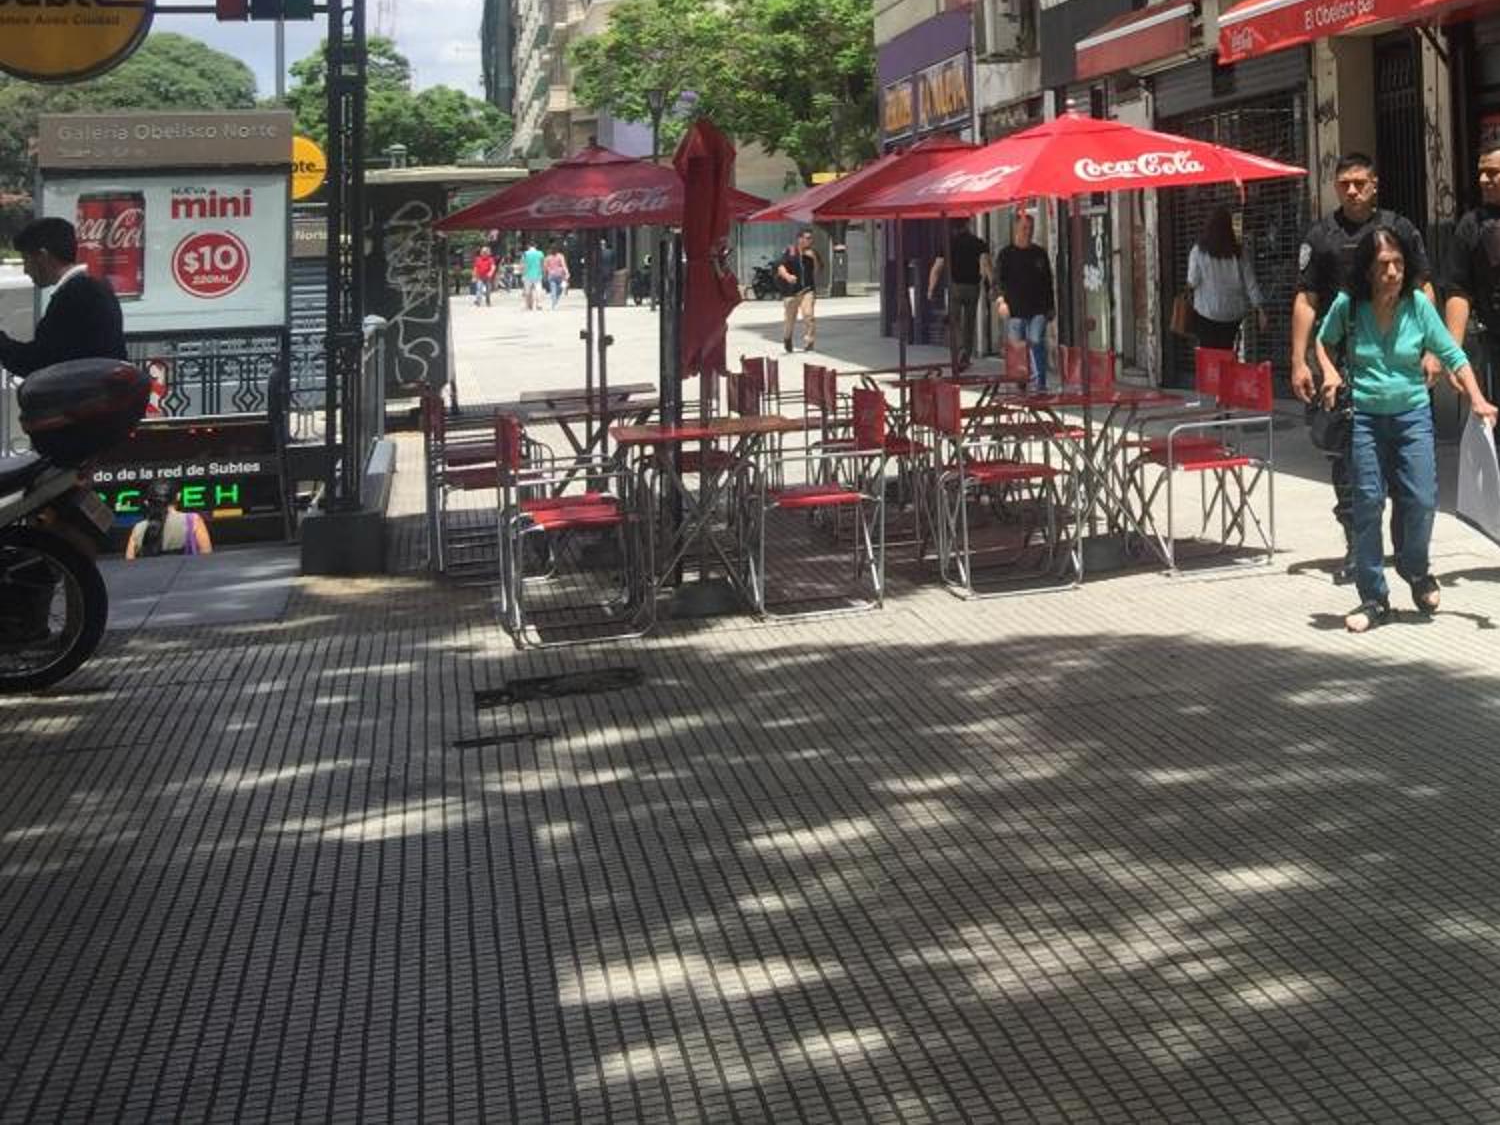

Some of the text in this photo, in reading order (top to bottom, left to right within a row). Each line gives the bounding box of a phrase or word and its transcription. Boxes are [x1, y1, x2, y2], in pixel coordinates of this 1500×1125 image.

[1305, 10, 1315, 30] El
[1315, 0, 1355, 26] Obelisco
[1073, 150, 1205, 182] Coca-Cola
[171, 189, 252, 219] mini
[183, 245, 239, 273] $10
[117, 468, 136, 481] de
[140, 467, 153, 479] la
[157, 463, 182, 478] red
[186, 464, 205, 475] de
[209, 461, 260, 475] Subtes
[181, 486, 206, 507] E
[215, 483, 238, 505] H
